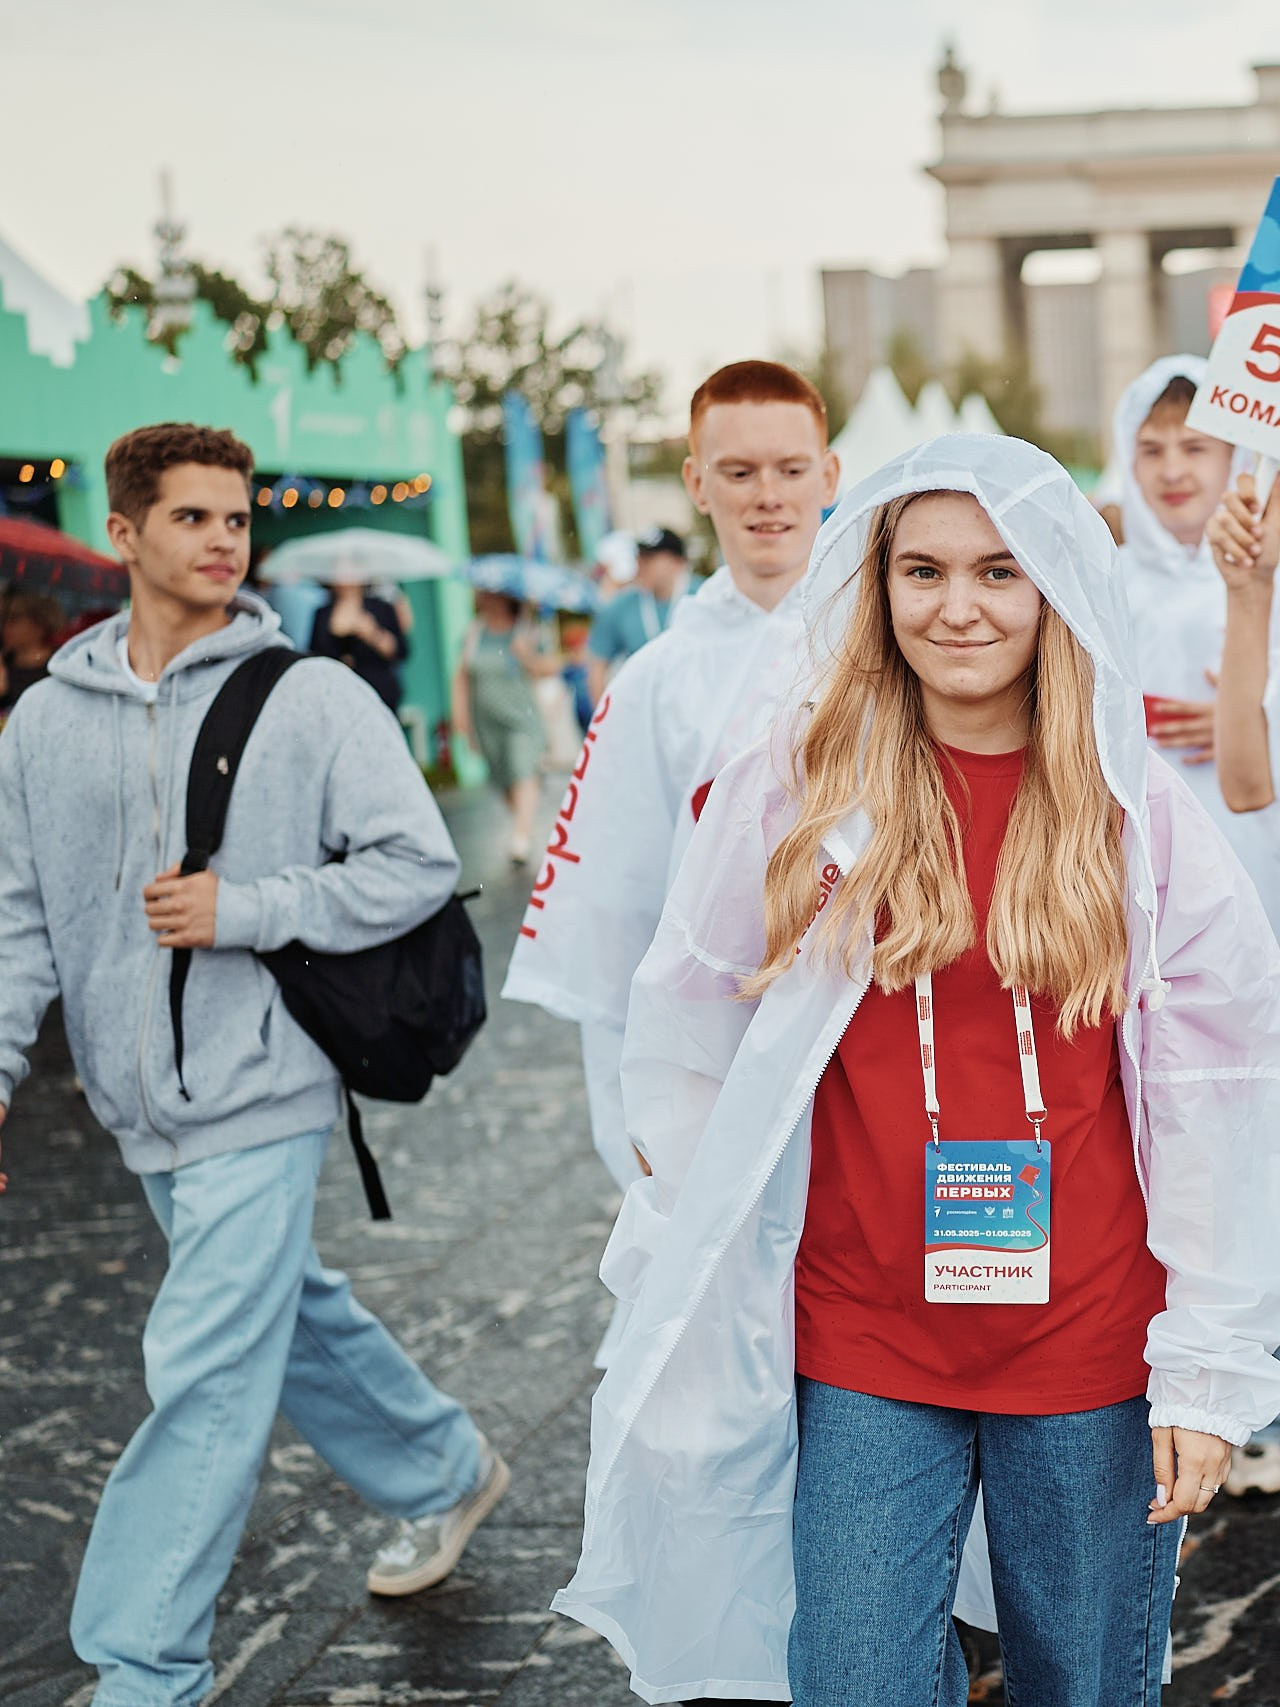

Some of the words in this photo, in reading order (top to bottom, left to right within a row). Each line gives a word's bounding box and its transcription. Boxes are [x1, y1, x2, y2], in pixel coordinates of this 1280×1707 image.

[936, 1163, 1012, 1172] ФЕСТИВАЛЬ
[936, 1174, 1012, 1184] ДВИЖЕНИЯ
[936, 1187, 1012, 1198] ПЕРВЫХ
[934, 1265, 1033, 1278] УЧАСТНИК
